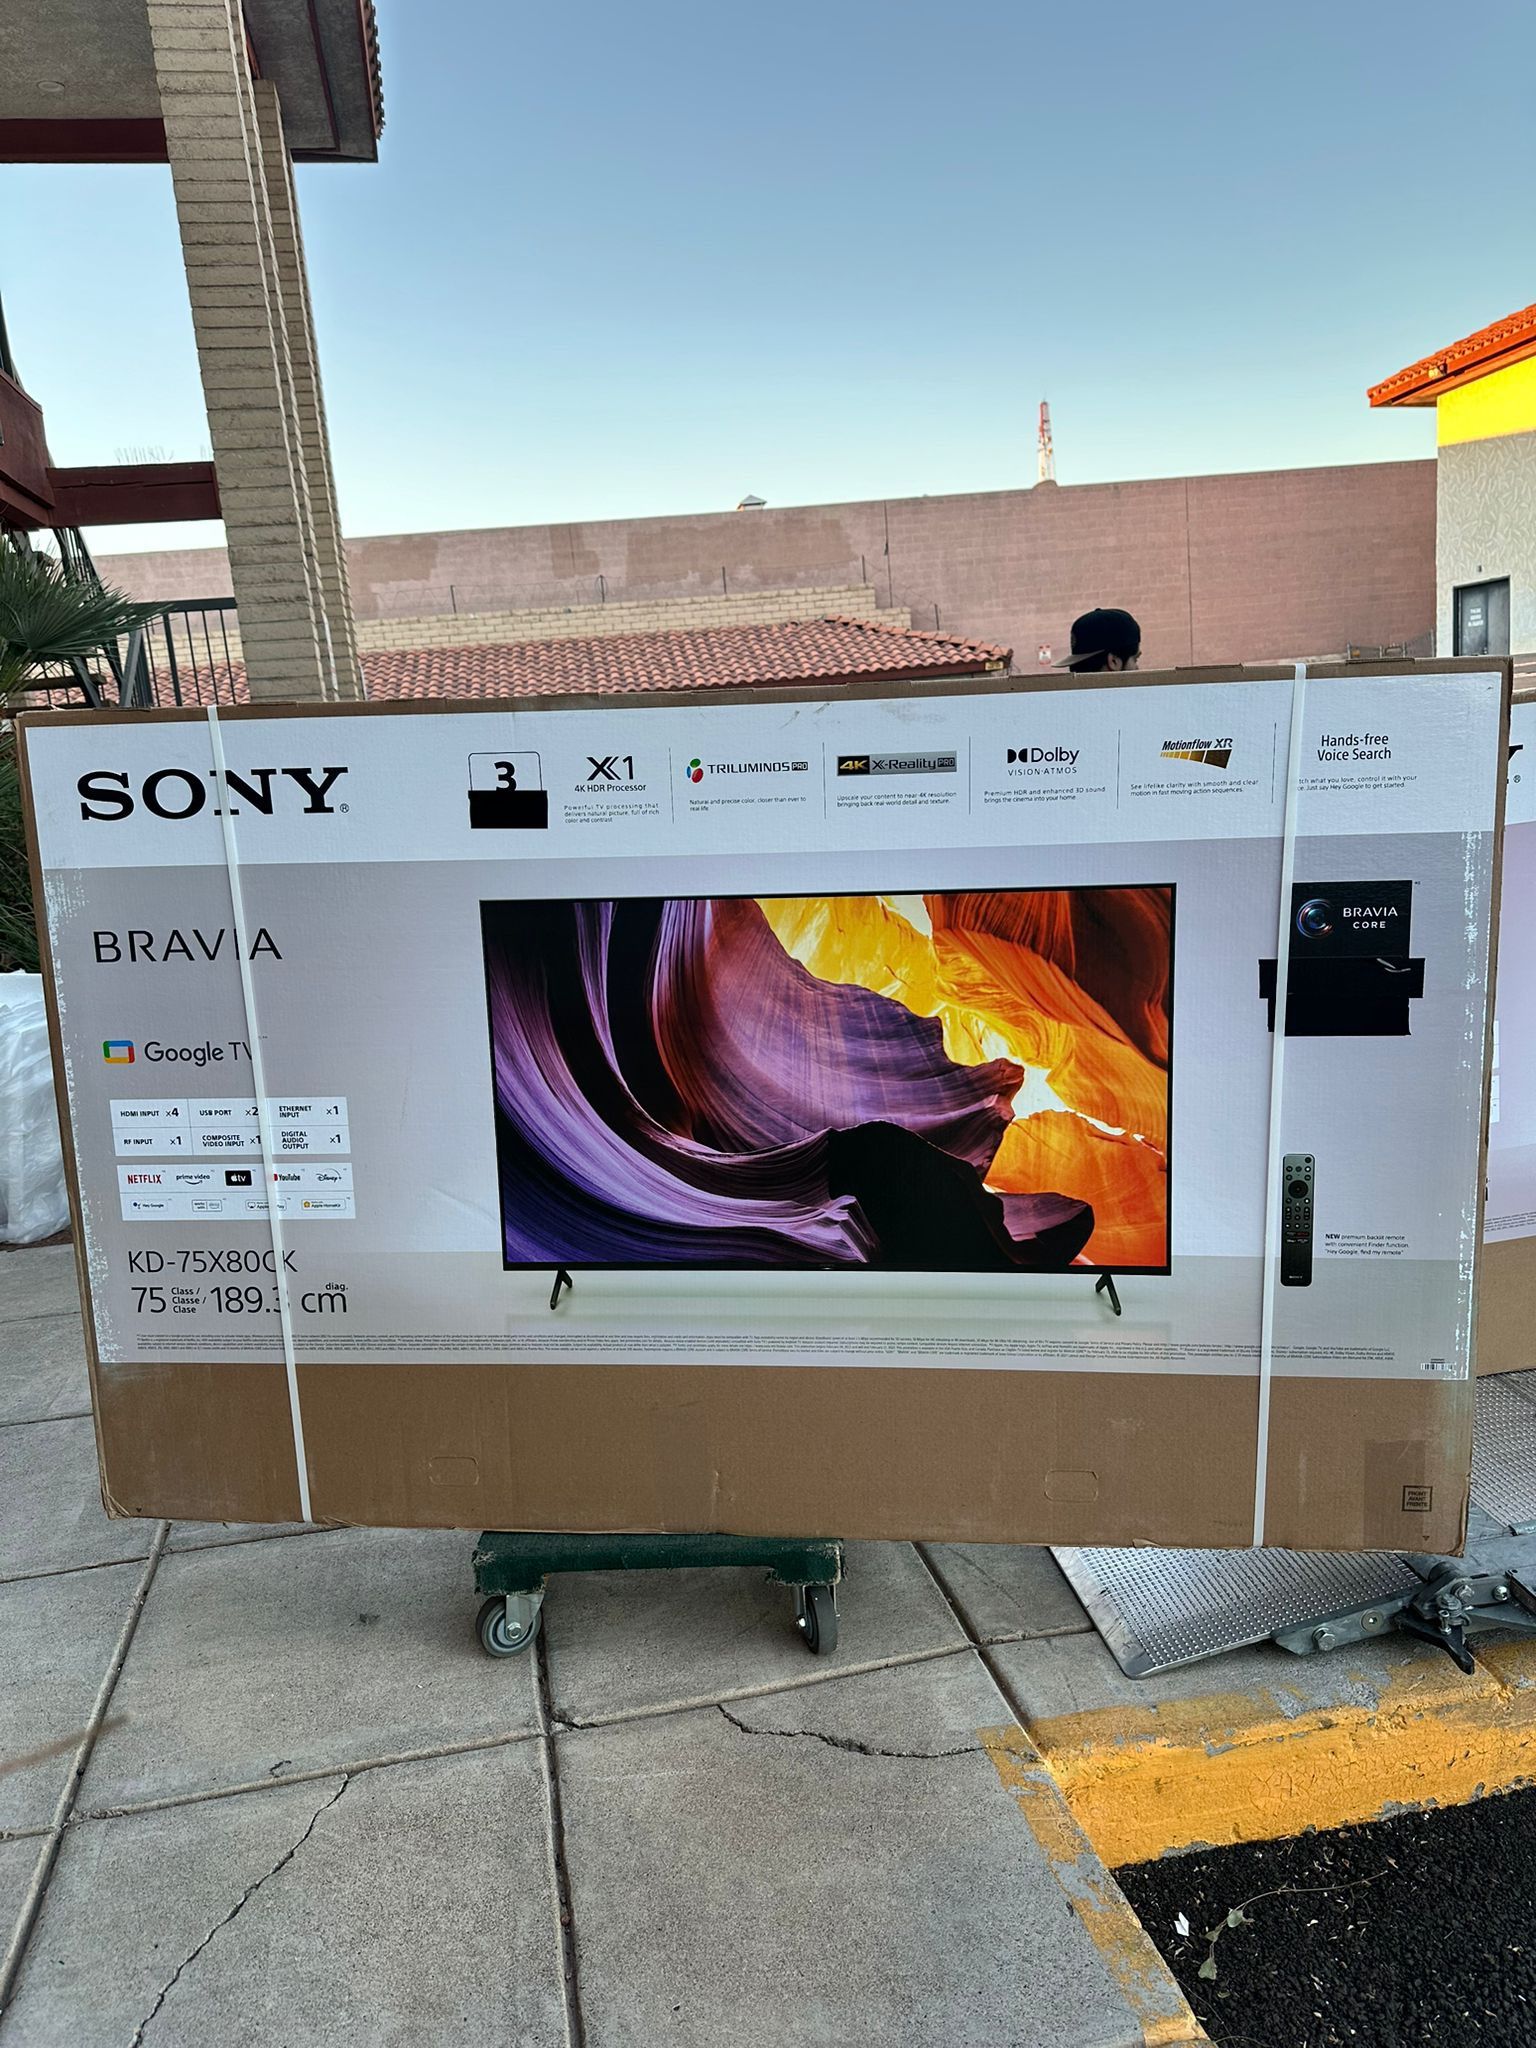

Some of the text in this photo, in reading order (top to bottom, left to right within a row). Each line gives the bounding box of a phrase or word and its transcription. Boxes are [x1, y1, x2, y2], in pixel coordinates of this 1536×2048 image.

[1162, 737, 1233, 751] Motionflow XR
[1321, 733, 1389, 747] Hands-free
[1031, 746, 1080, 765] Dolby
[1317, 747, 1391, 761] Voice Search
[707, 762, 808, 774] TRILUMINOS PRO
[840, 760, 868, 770] 4K
[938, 757, 955, 768] PRO
[494, 761, 517, 792] 3
[574, 783, 647, 793] 4K HDR Processor
[1042, 787, 1074, 795] enhanced
[1144, 782, 1165, 790] lifelike
[1342, 783, 1364, 791] Google
[77, 767, 348, 821] SONY
[1343, 906, 1398, 918] BRAVIA
[1353, 921, 1387, 929] CORE
[93, 928, 283, 963] BRAVIA
[144, 1041, 224, 1067] Google
[127, 1174, 162, 1184] NETFLIX
[176, 1173, 193, 1181] prime
[237, 1174, 247, 1182] tv
[279, 1173, 300, 1181] YouTube
[171, 1287, 194, 1295] Class
[325, 1282, 349, 1292] diag.
[131, 1287, 166, 1313] 75
[172, 1296, 200, 1304] Classe
[301, 1292, 347, 1313] cm
[173, 1305, 197, 1313] Clase
